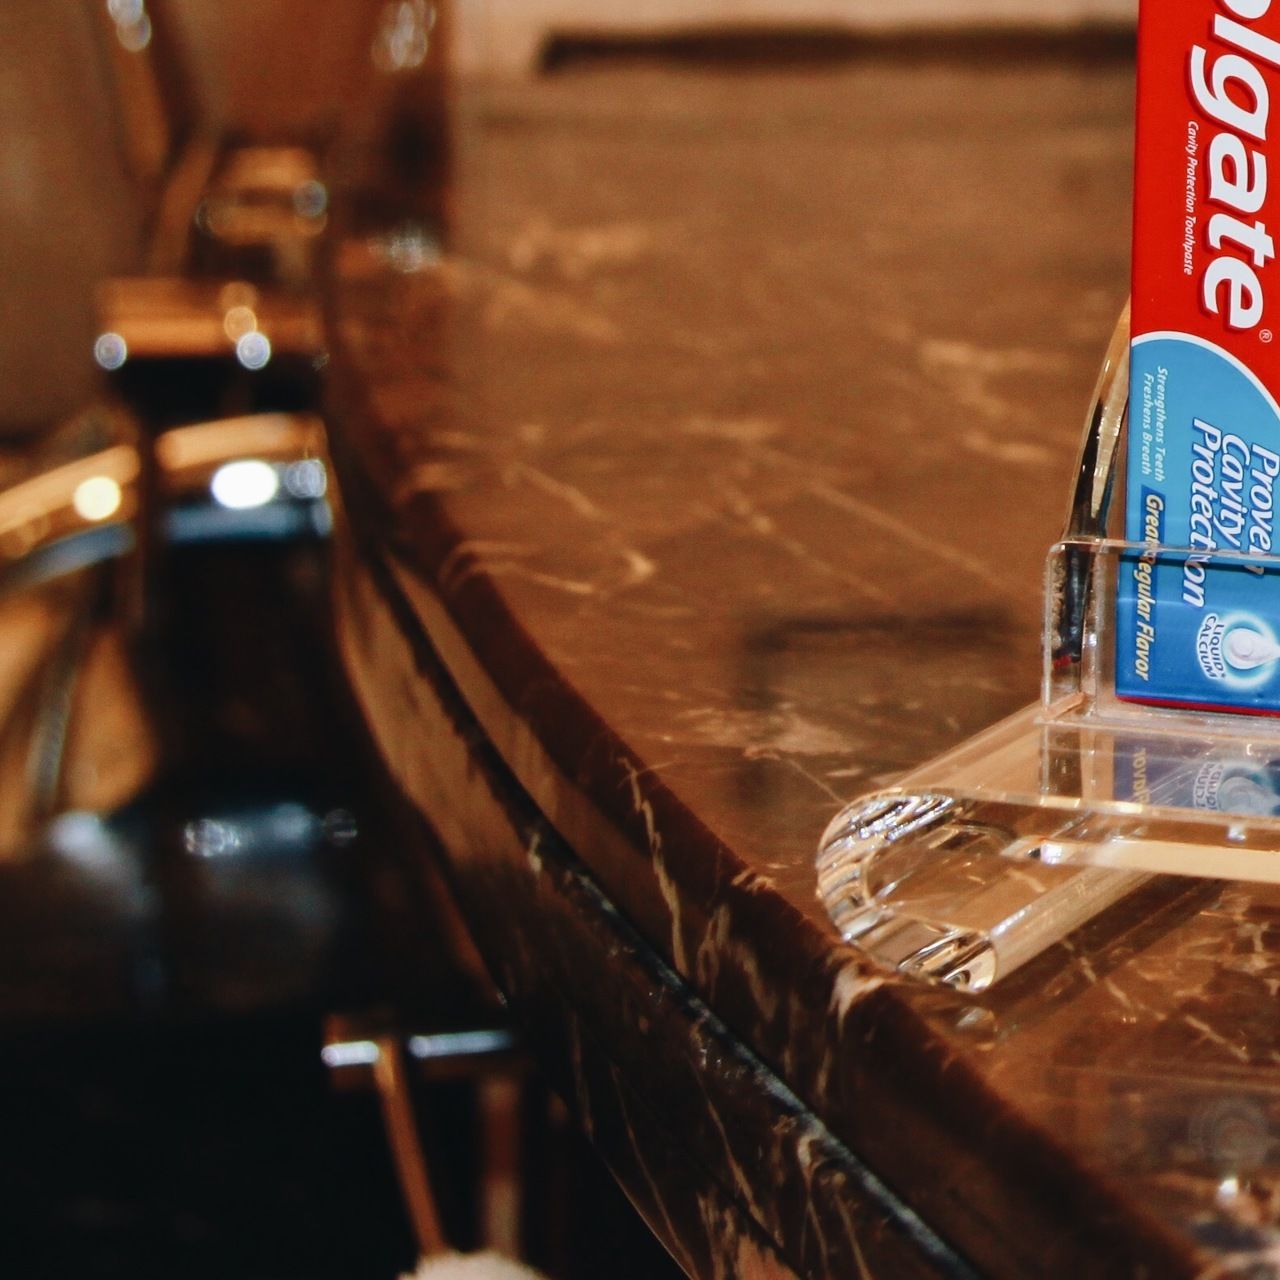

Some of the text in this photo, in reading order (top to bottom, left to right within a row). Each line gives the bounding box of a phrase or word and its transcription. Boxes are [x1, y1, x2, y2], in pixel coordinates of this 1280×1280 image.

[1184, 120, 1199, 276] Cavity Protection Toothpaste
[1140, 373, 1154, 475] Freshens Breath
[1153, 366, 1168, 482] Strengthens Teeth
[1213, 433, 1250, 548] Cavity
[1135, 621, 1154, 681] Flavor
[1199, 615, 1217, 679] CALCIUM
